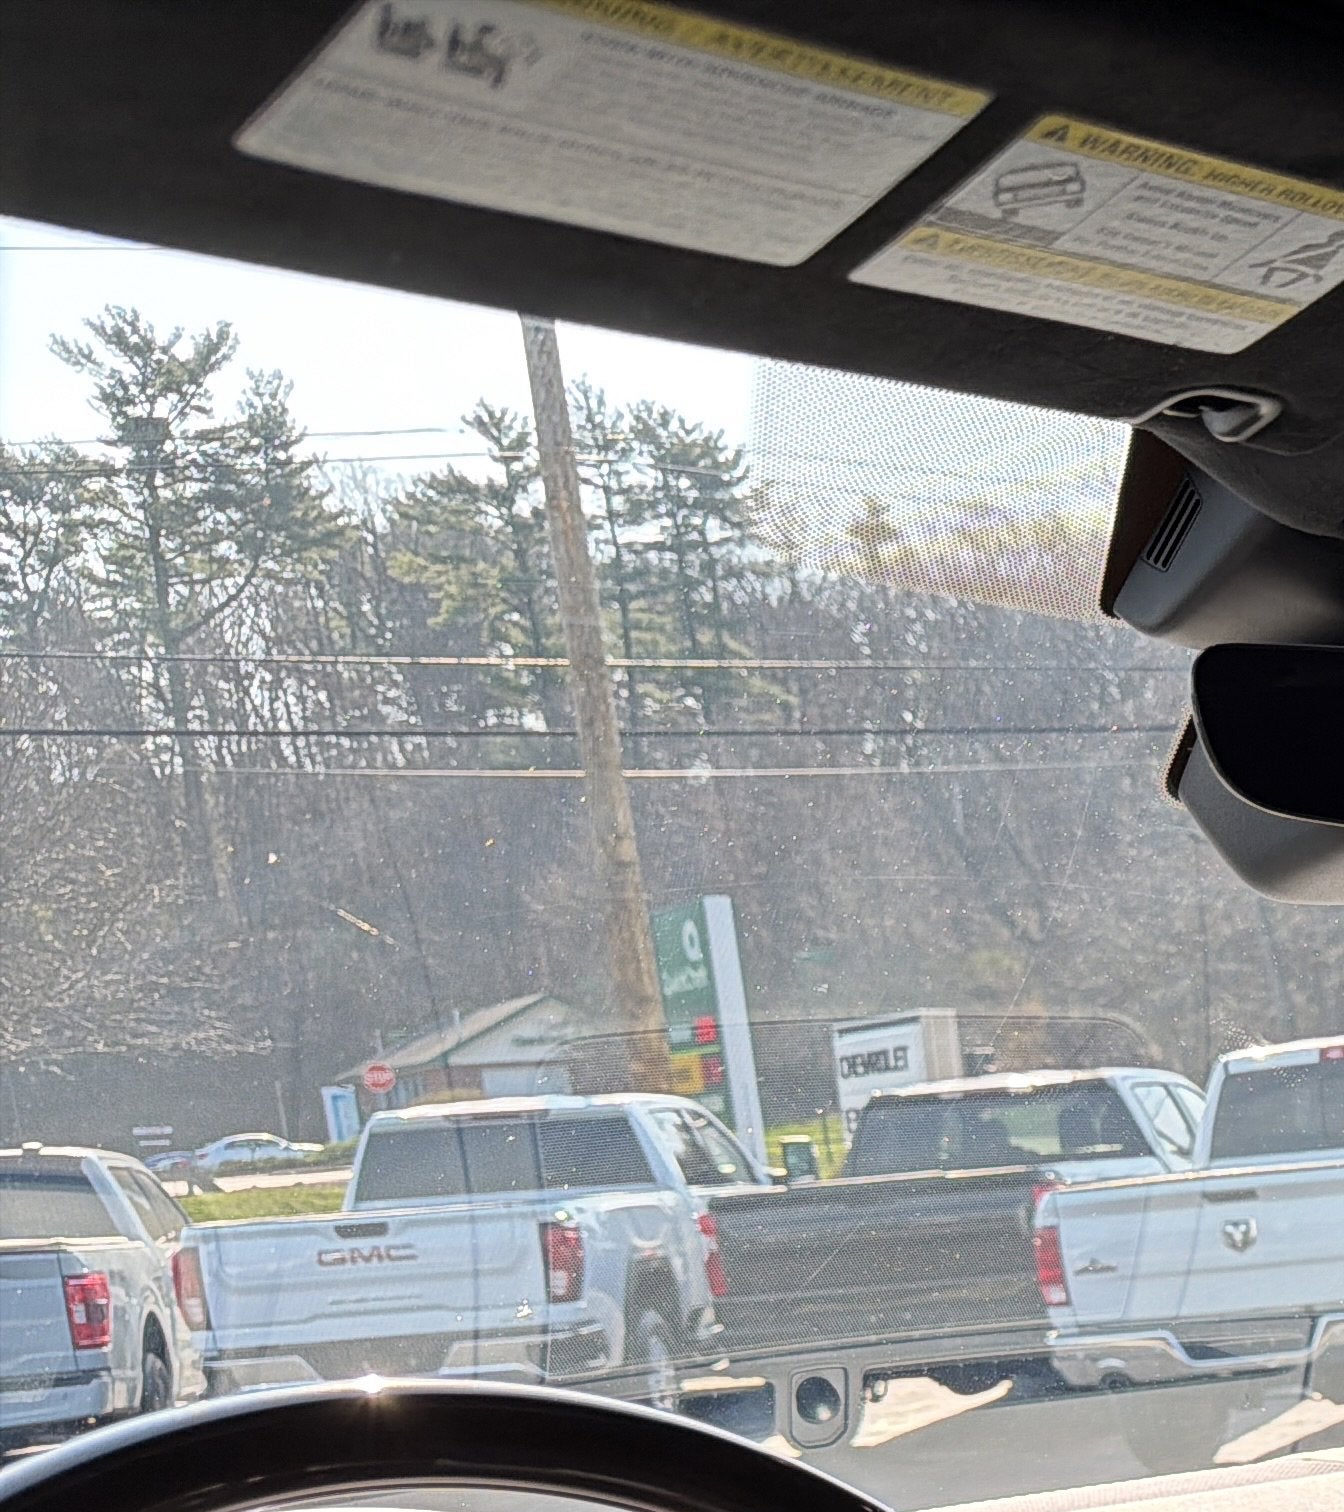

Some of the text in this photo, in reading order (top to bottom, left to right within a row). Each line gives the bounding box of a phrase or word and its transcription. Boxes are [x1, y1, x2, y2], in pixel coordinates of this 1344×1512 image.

[839, 1045, 909, 1079] CHEVROLET
[366, 1071, 395, 1083] STOP
[317, 1242, 419, 1267] GMC
